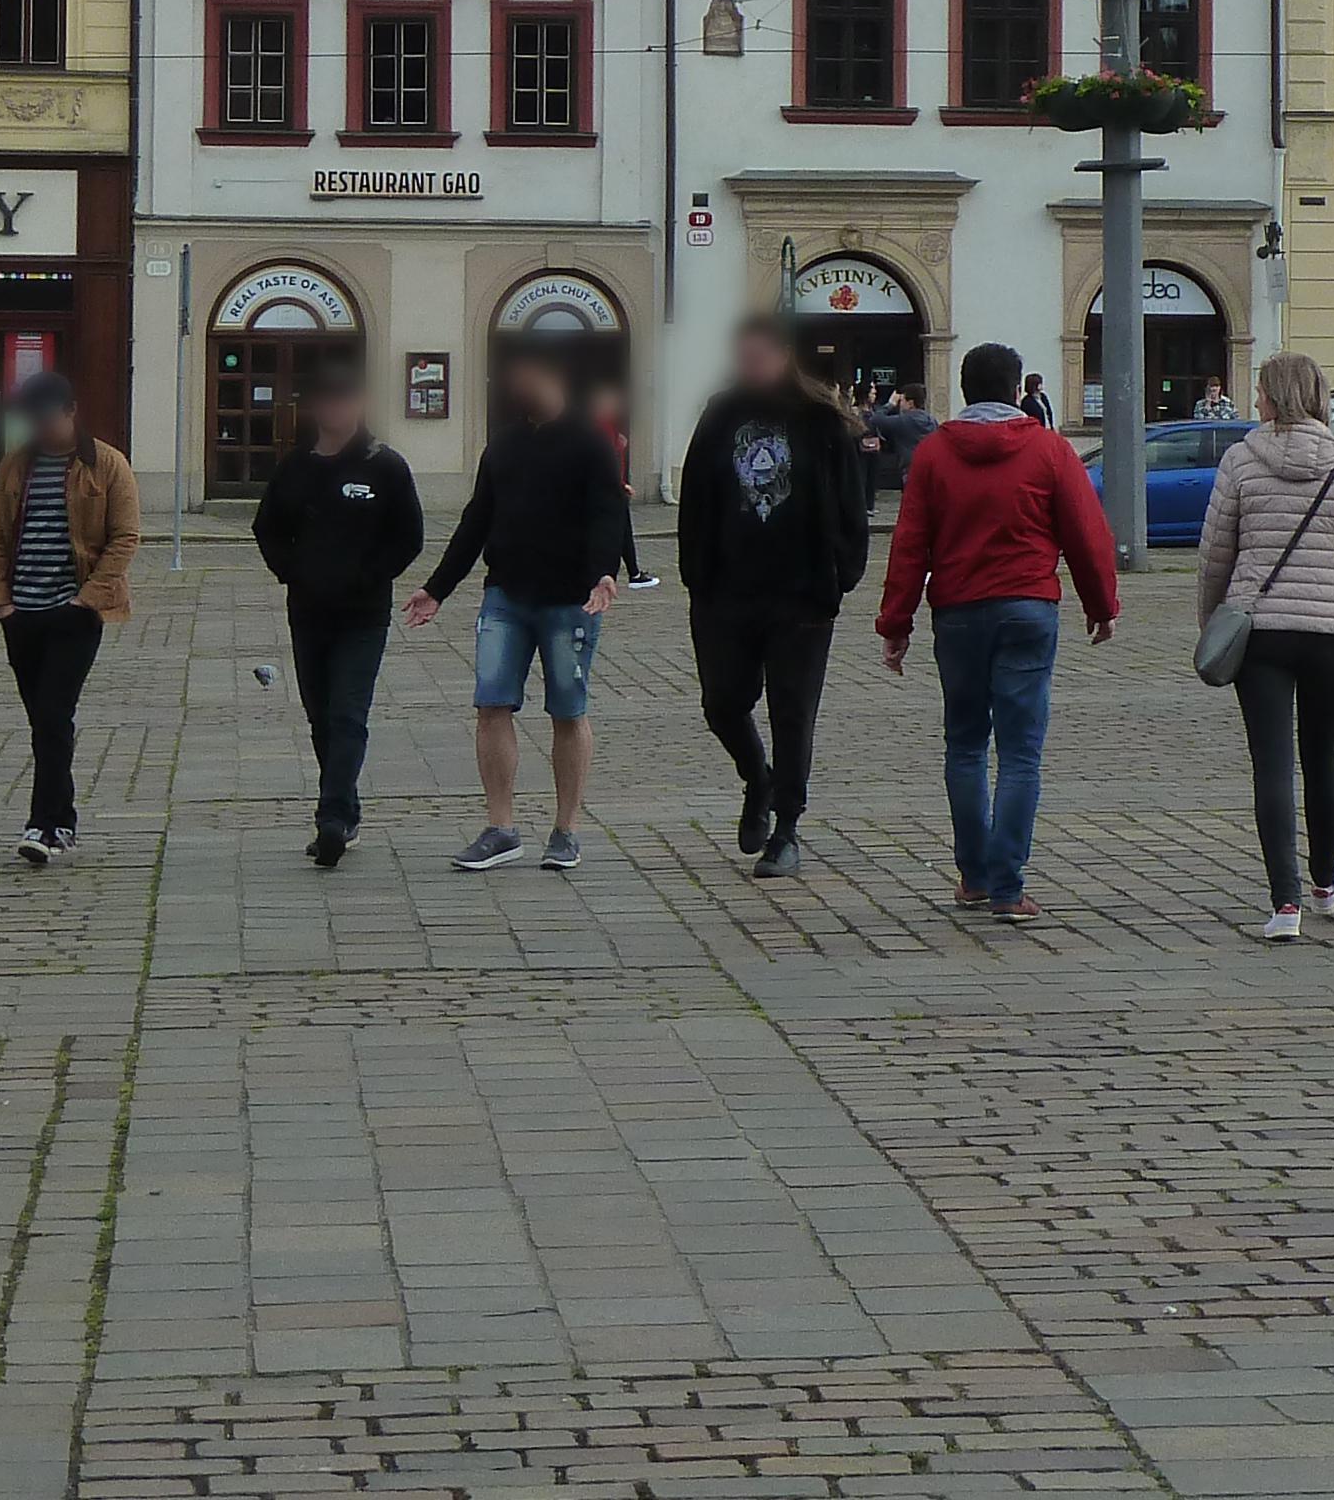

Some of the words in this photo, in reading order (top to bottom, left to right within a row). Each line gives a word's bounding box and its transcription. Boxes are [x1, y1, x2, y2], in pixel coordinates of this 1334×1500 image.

[314, 171, 436, 193] RESTAURANT
[442, 172, 480, 194] GAO
[695, 214, 706, 224] 19
[229, 289, 256, 317] REAL
[257, 275, 297, 291] TASTE
[300, 279, 319, 292] OF
[318, 291, 342, 319] ASIA
[795, 269, 879, 298] KVĚTINY
[879, 280, 897, 298] K
[1142, 270, 1180, 299] dea
[509, 282, 558, 322] SKUTEČNÁ
[561, 285, 591, 301] CHUŤ
[589, 300, 608, 322] ASIE
